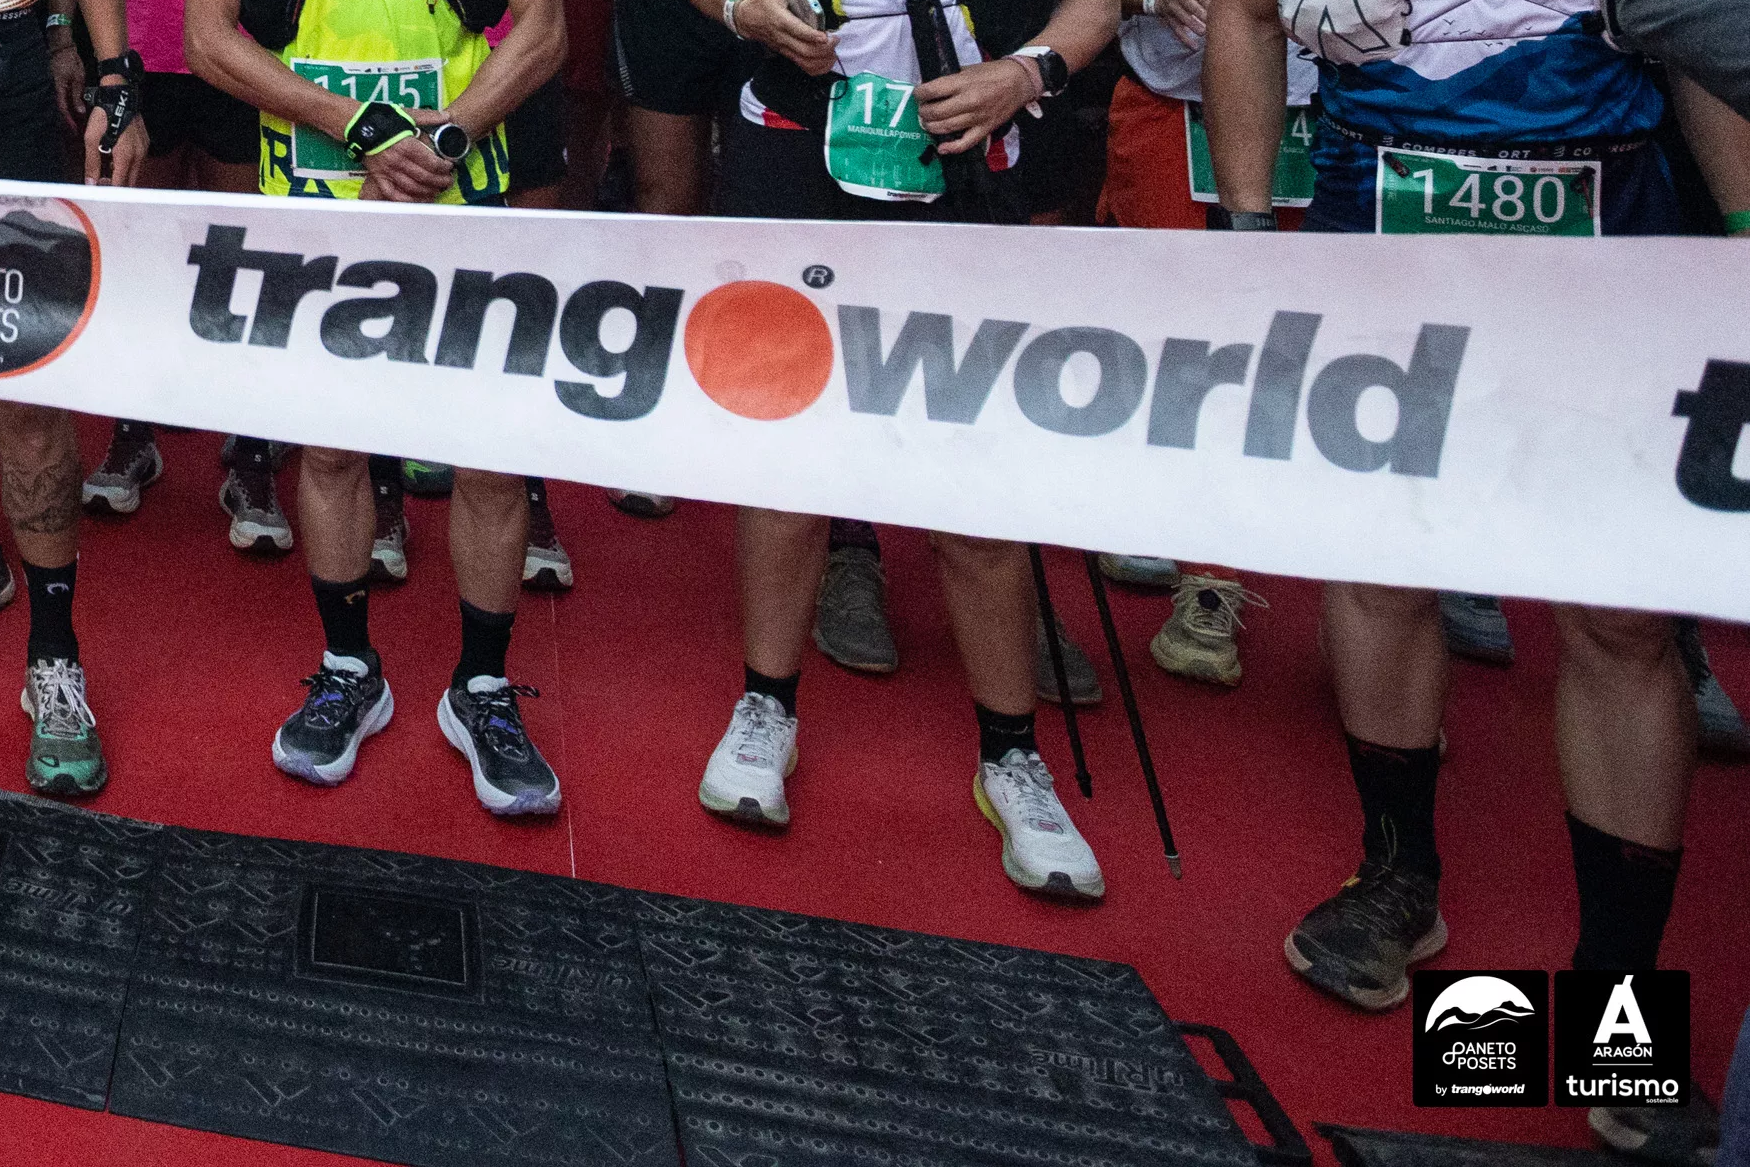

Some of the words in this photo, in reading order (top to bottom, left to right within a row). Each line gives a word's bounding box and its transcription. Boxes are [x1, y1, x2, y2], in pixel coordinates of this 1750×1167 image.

[111, 90, 129, 129] LEKI
[855, 81, 915, 128] 17
[1412, 168, 1566, 224] 1480
[1424, 216, 1476, 229] SANTIAGO
